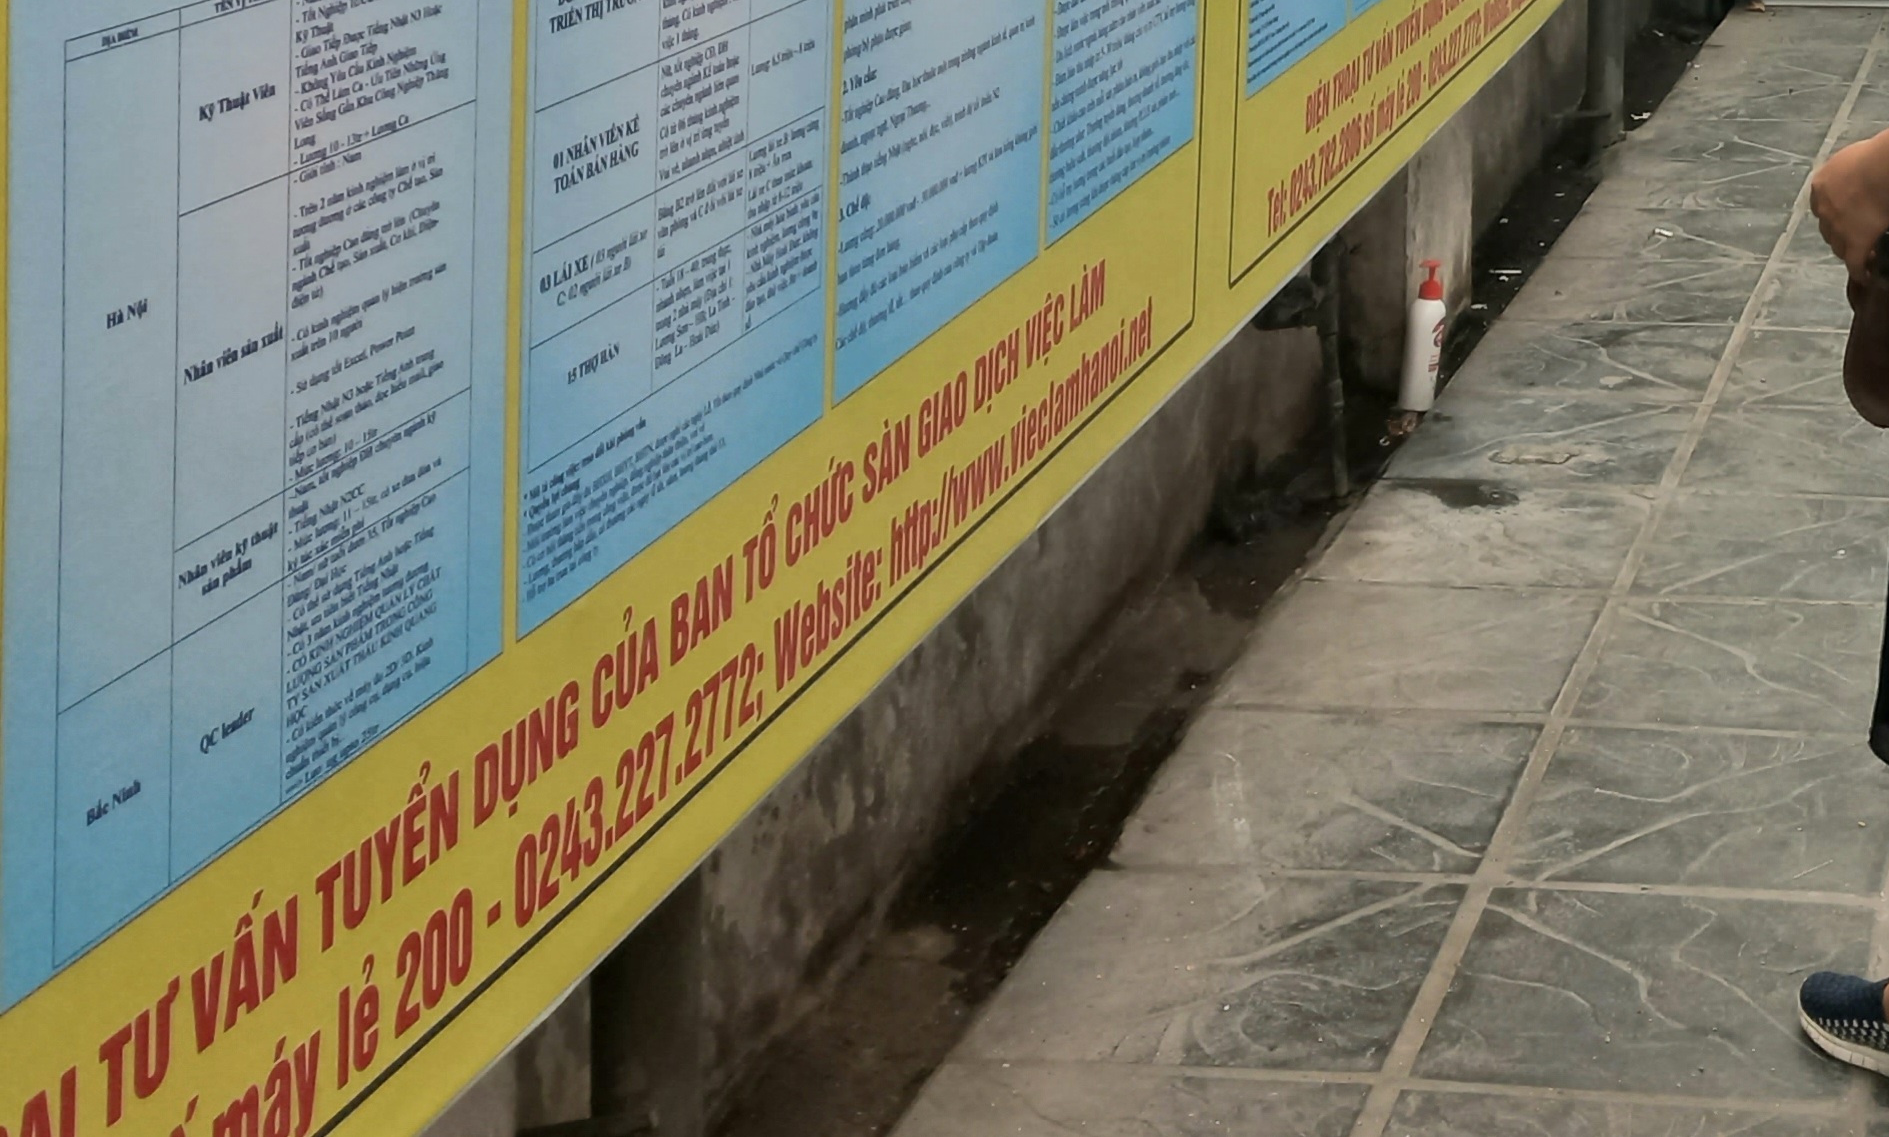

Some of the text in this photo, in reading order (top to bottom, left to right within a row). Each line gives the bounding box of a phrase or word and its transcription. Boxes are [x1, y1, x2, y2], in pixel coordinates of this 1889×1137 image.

[99, 976, 181, 1128] TƯ
[191, 889, 299, 1053] VẤN
[314, 760, 459, 953] TUYỂN
[473, 681, 579, 827] DỤNG
[592, 605, 658, 730] CỦA
[670, 556, 733, 667] BAN
[743, 493, 780, 604] TỔ
[785, 455, 854, 568] CHỨC
[862, 420, 909, 504] SÀN
[918, 371, 968, 459] GIAO
[973, 331, 1019, 414] DỊCH
[1026, 292, 1064, 371] VIỆC
[1071, 258, 1105, 335] LÀM
[337, 954, 380, 1091] lẻ
[394, 888, 474, 1040] 200
[514, 642, 765, 925] 0243.227.2772;
[773, 548, 882, 693] Website:
[889, 296, 1153, 583] http://www.vieclamhanoi.net
